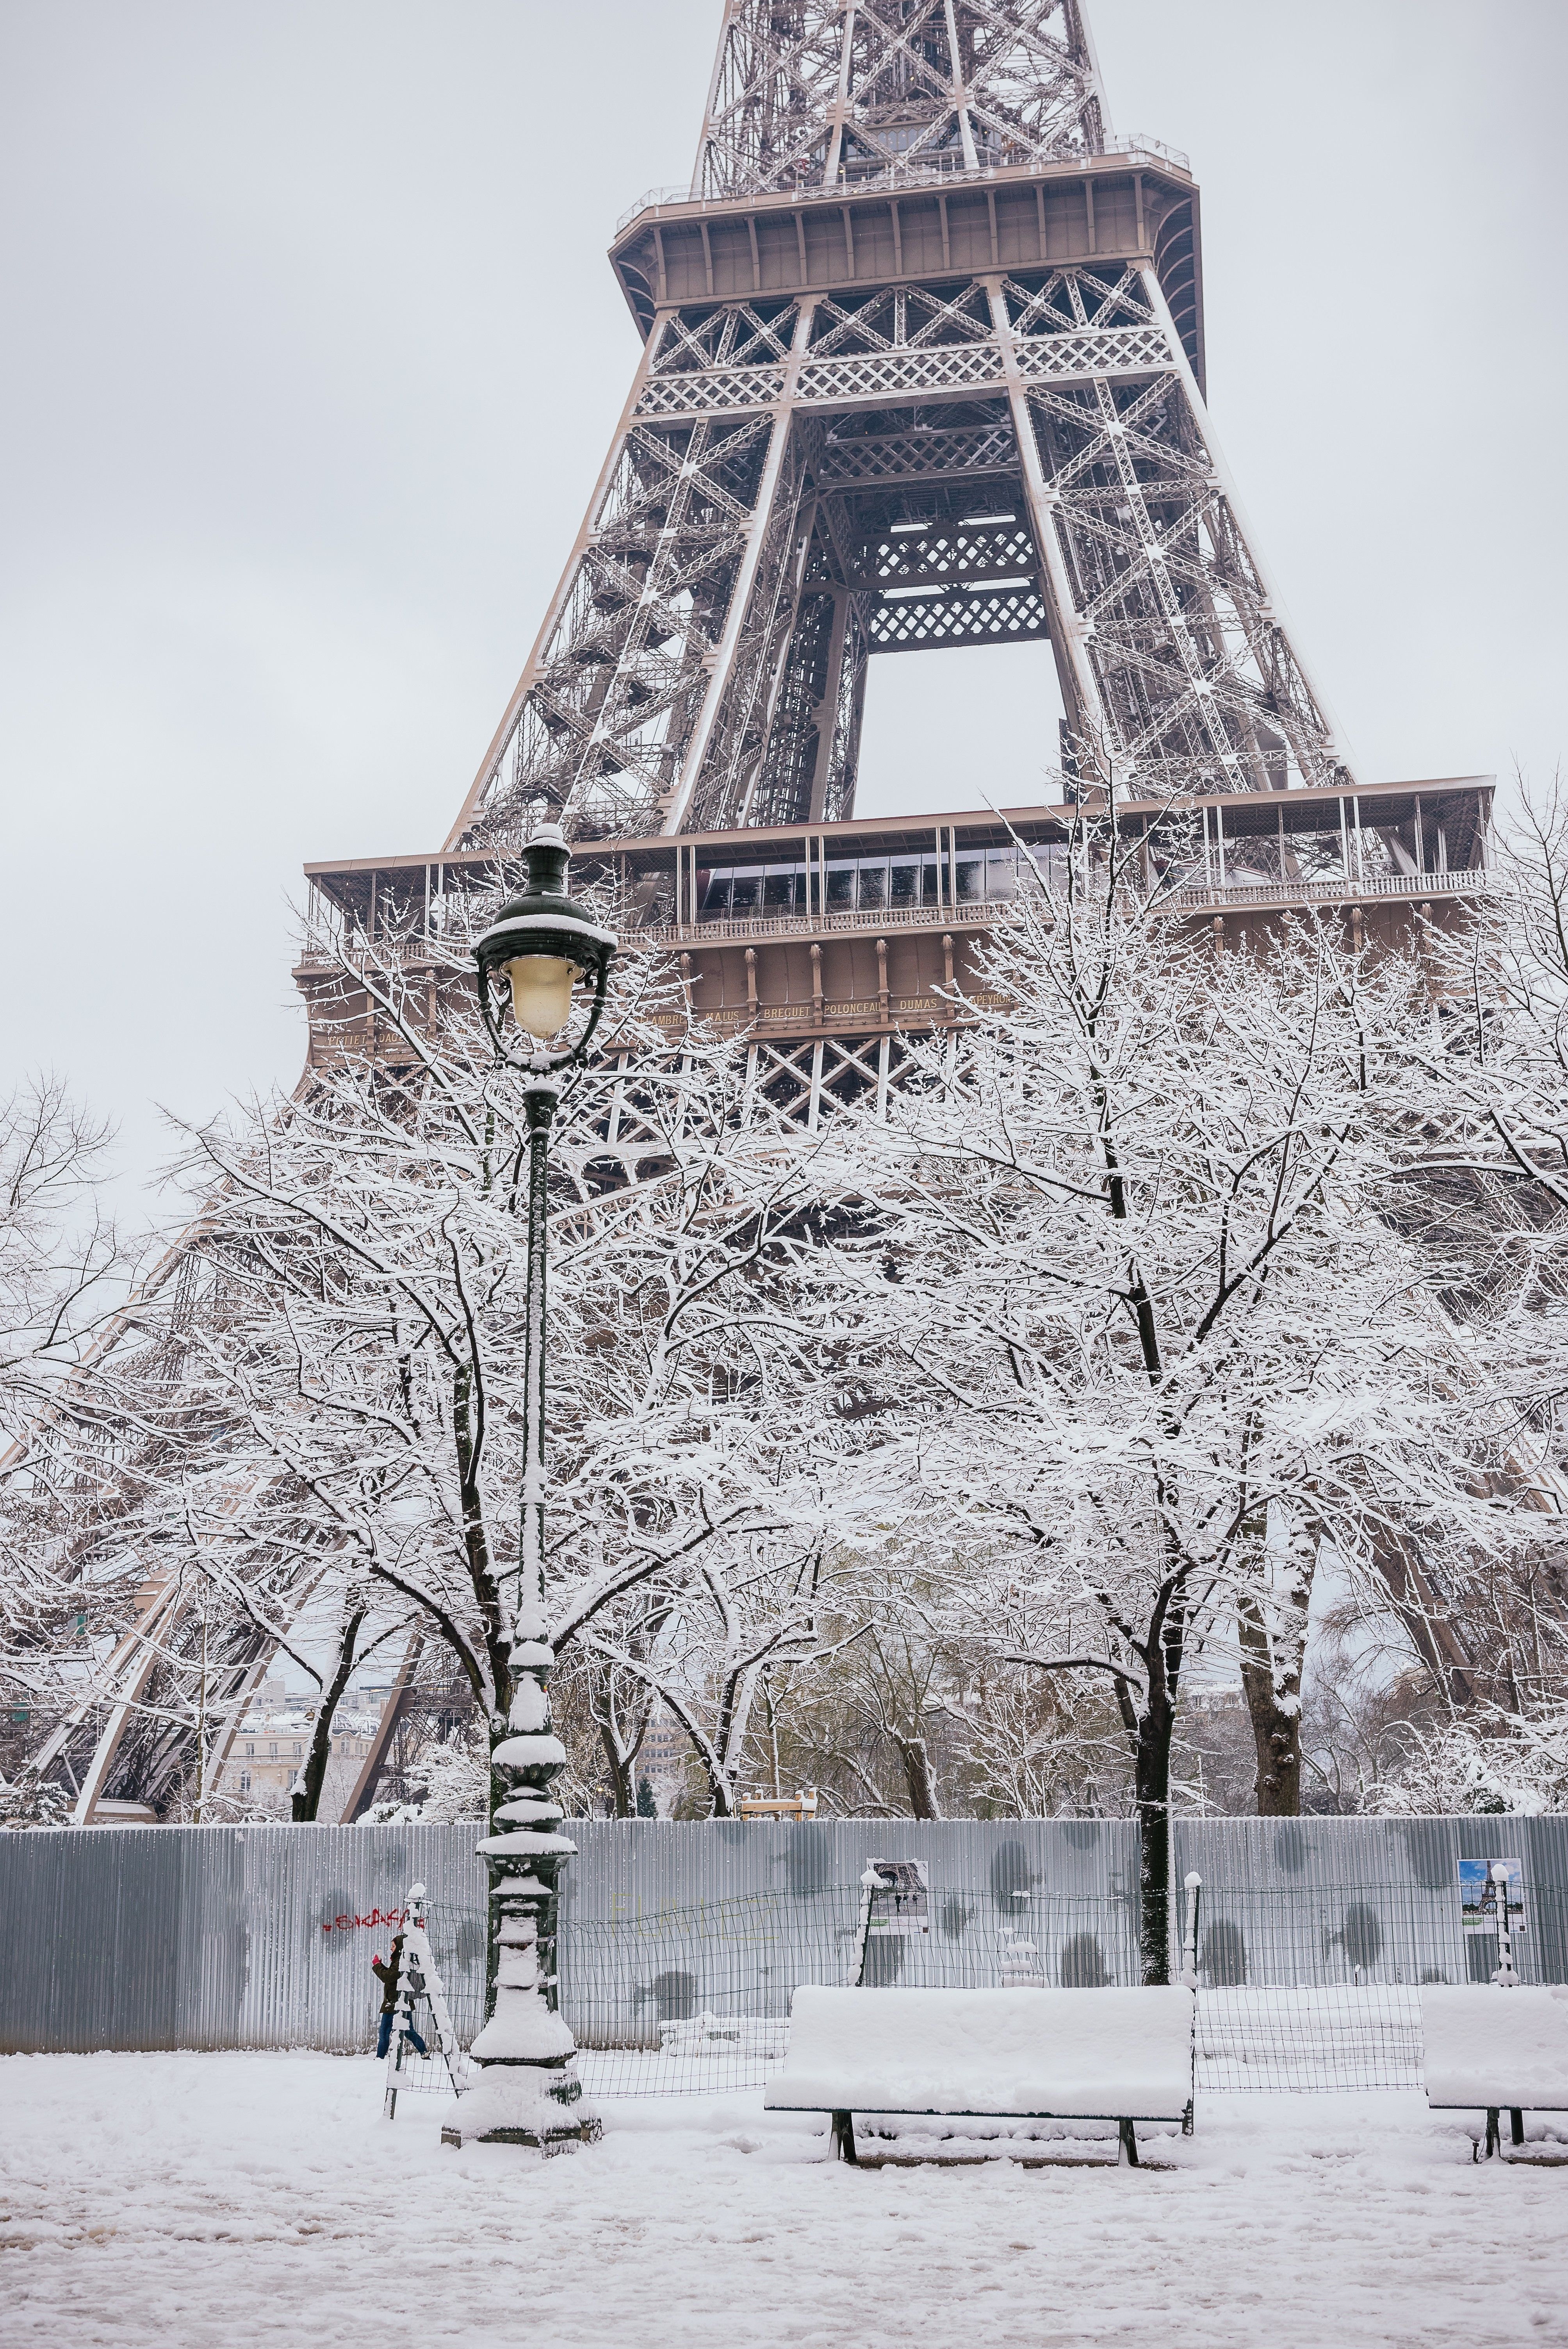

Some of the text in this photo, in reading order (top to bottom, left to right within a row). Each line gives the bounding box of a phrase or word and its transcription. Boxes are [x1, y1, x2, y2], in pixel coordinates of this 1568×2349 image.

[824, 1002, 880, 1014] POLONCEAU
[900, 998, 937, 1010] DUMAS
[706, 1011, 739, 1021] MALUS
[764, 1007, 811, 1018] BREGUET
[328, 1035, 367, 1046] PETIET
